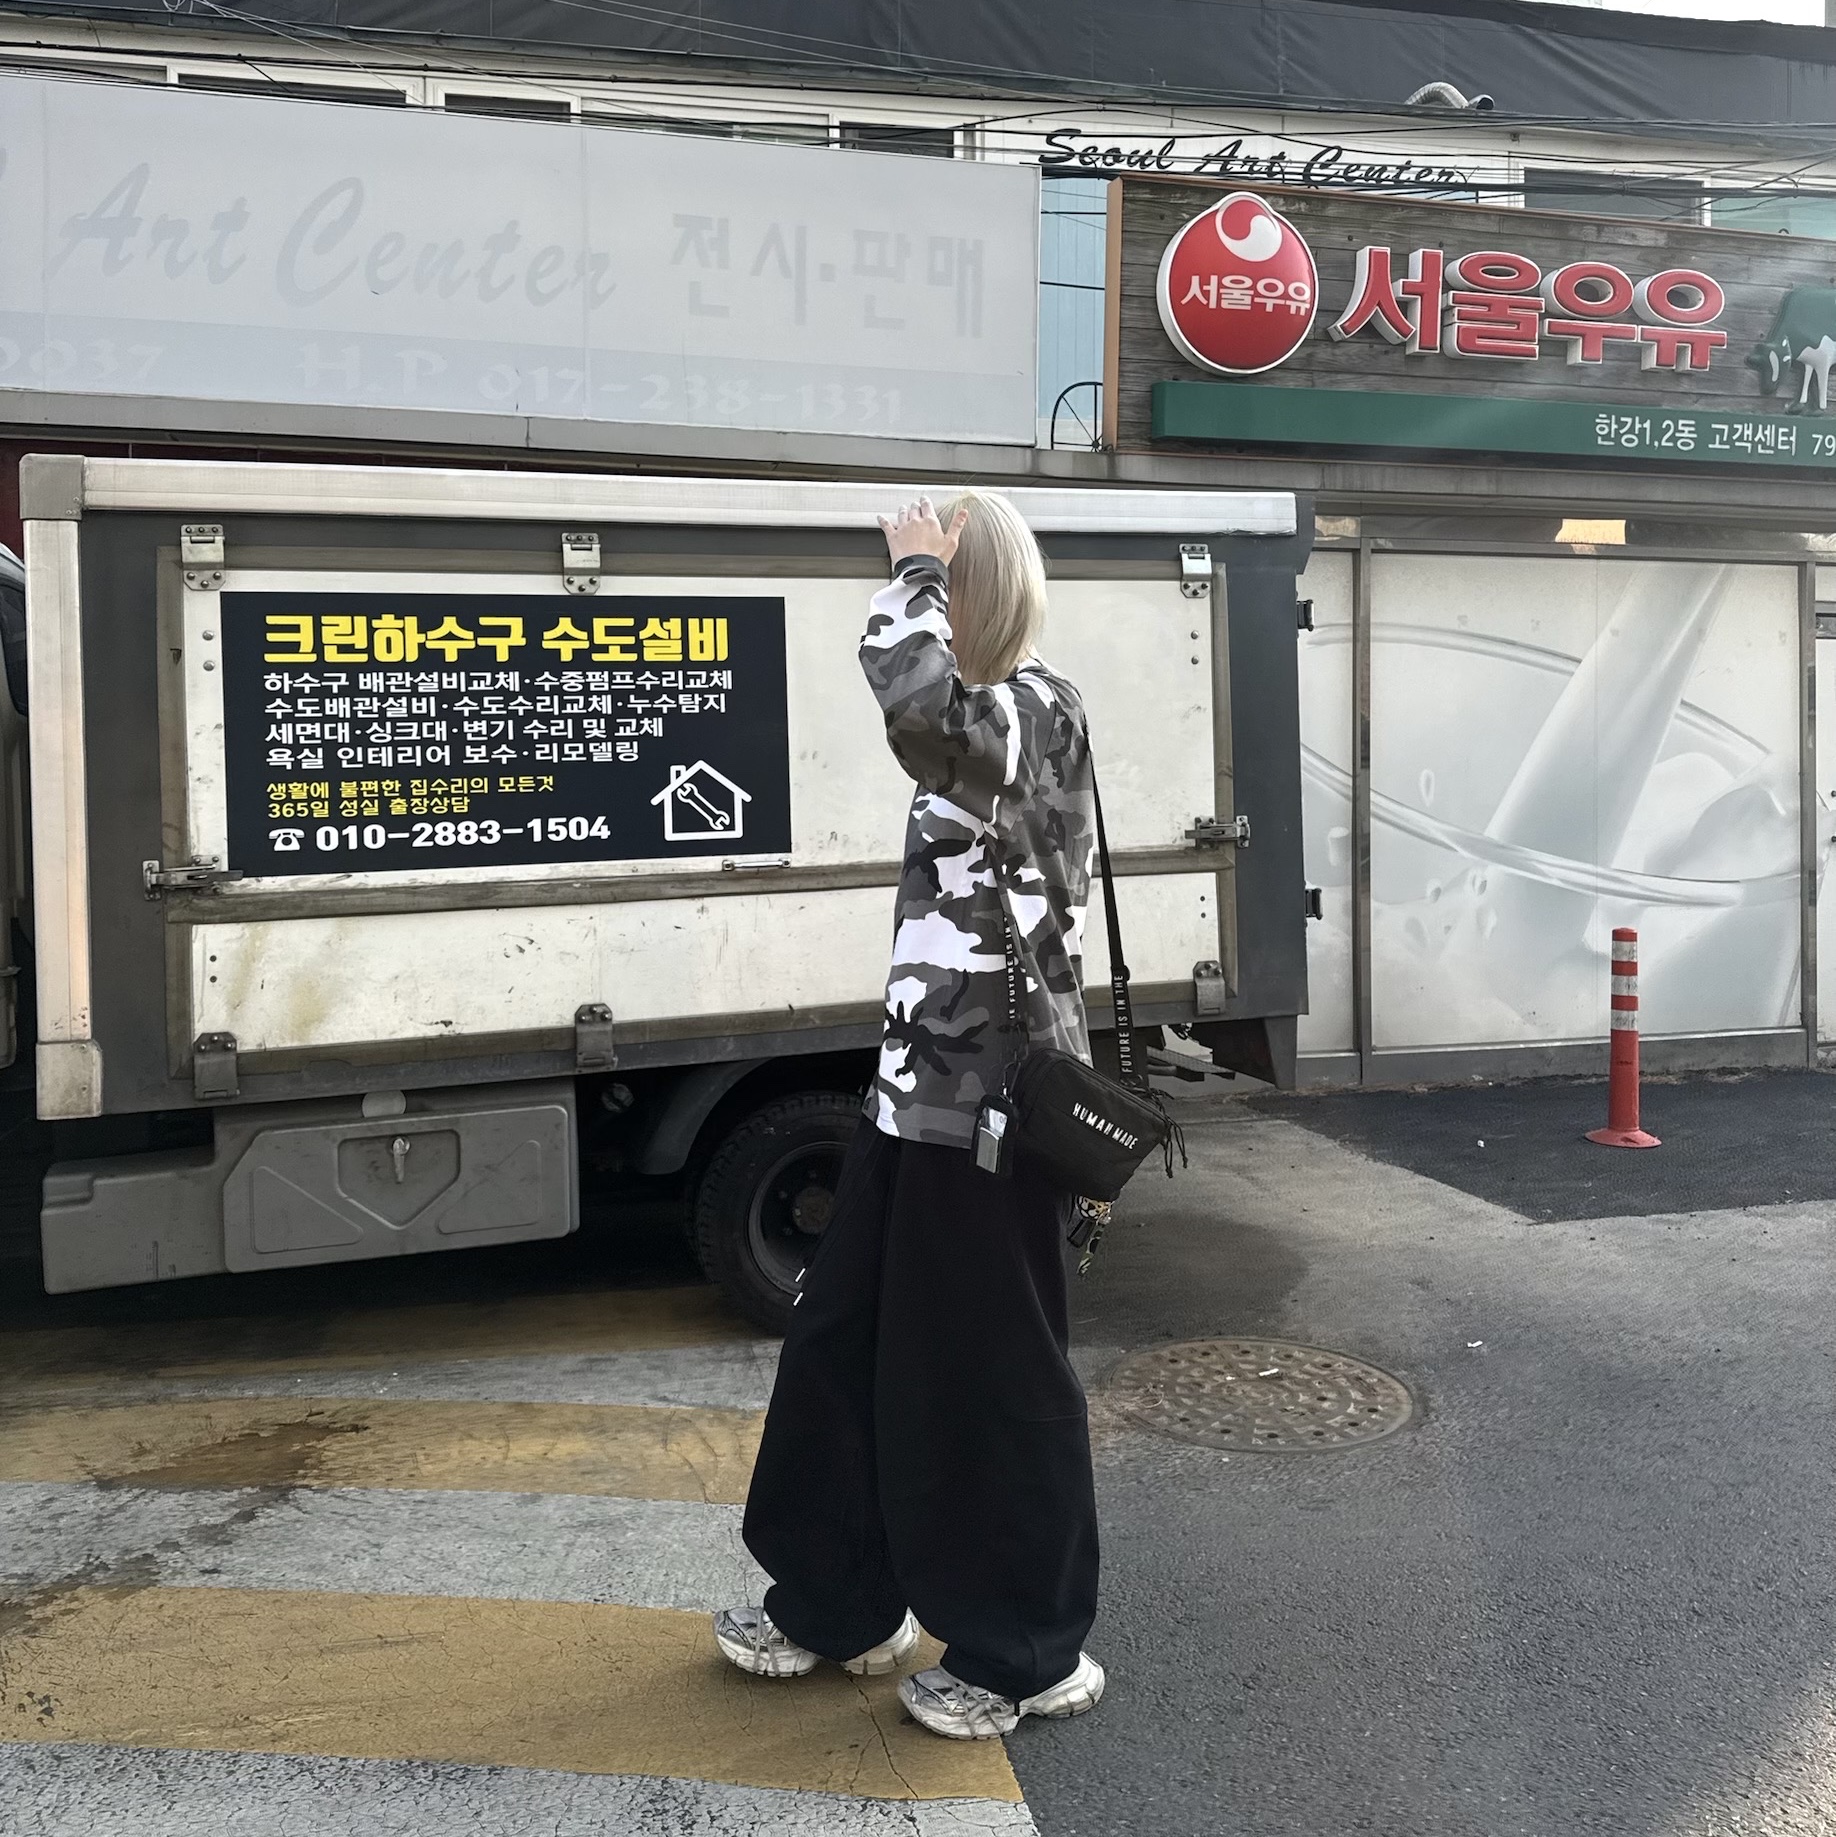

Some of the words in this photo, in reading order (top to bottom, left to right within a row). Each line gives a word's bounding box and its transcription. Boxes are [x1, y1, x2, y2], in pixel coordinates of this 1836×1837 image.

[1038, 128, 1177, 170] Seoul
[1193, 139, 1287, 179] Art
[1302, 145, 1465, 185] Center
[44, 161, 251, 286] Art
[275, 175, 618, 310] Center
[1180, 274, 1311, 315] 서울우유
[1328, 246, 1727, 372] 서울우유
[1595, 414, 1697, 451] 한강1,2동
[1708, 423, 1797, 456] 고객센터
[263, 614, 526, 663] 크린하수구
[542, 617, 729, 662] 수도설비
[263, 671, 350, 694] 하수구
[359, 670, 732, 692] 배관설비교체·수중펌프수리교체
[264, 720, 514, 744] 세면대·싱크대·변기
[523, 719, 574, 740] 수리
[582, 718, 607, 739] 및
[614, 717, 663, 739] 교체
[266, 747, 325, 769] 욕실
[339, 744, 452, 768] 인테리어
[463, 741, 639, 766] 보수·리모델링
[267, 781, 329, 801] 생활에
[339, 779, 401, 799] 불편한
[410, 777, 488, 797] 집수리의
[497, 775, 554, 794] 모든것
[268, 800, 329, 819] 365일
[339, 799, 380, 818] 성실
[389, 797, 470, 816] 출장상담
[316, 816, 611, 852] 010-2883-1504
[1114, 976, 1124, 994] THE
[1117, 999, 1126, 1010] IN
[1118, 1016, 1128, 1026] IS
[1119, 1032, 1133, 1072] FUTURE
[1073, 1103, 1114, 1135] HUMAN
[1112, 1127, 1138, 1149] MADE
